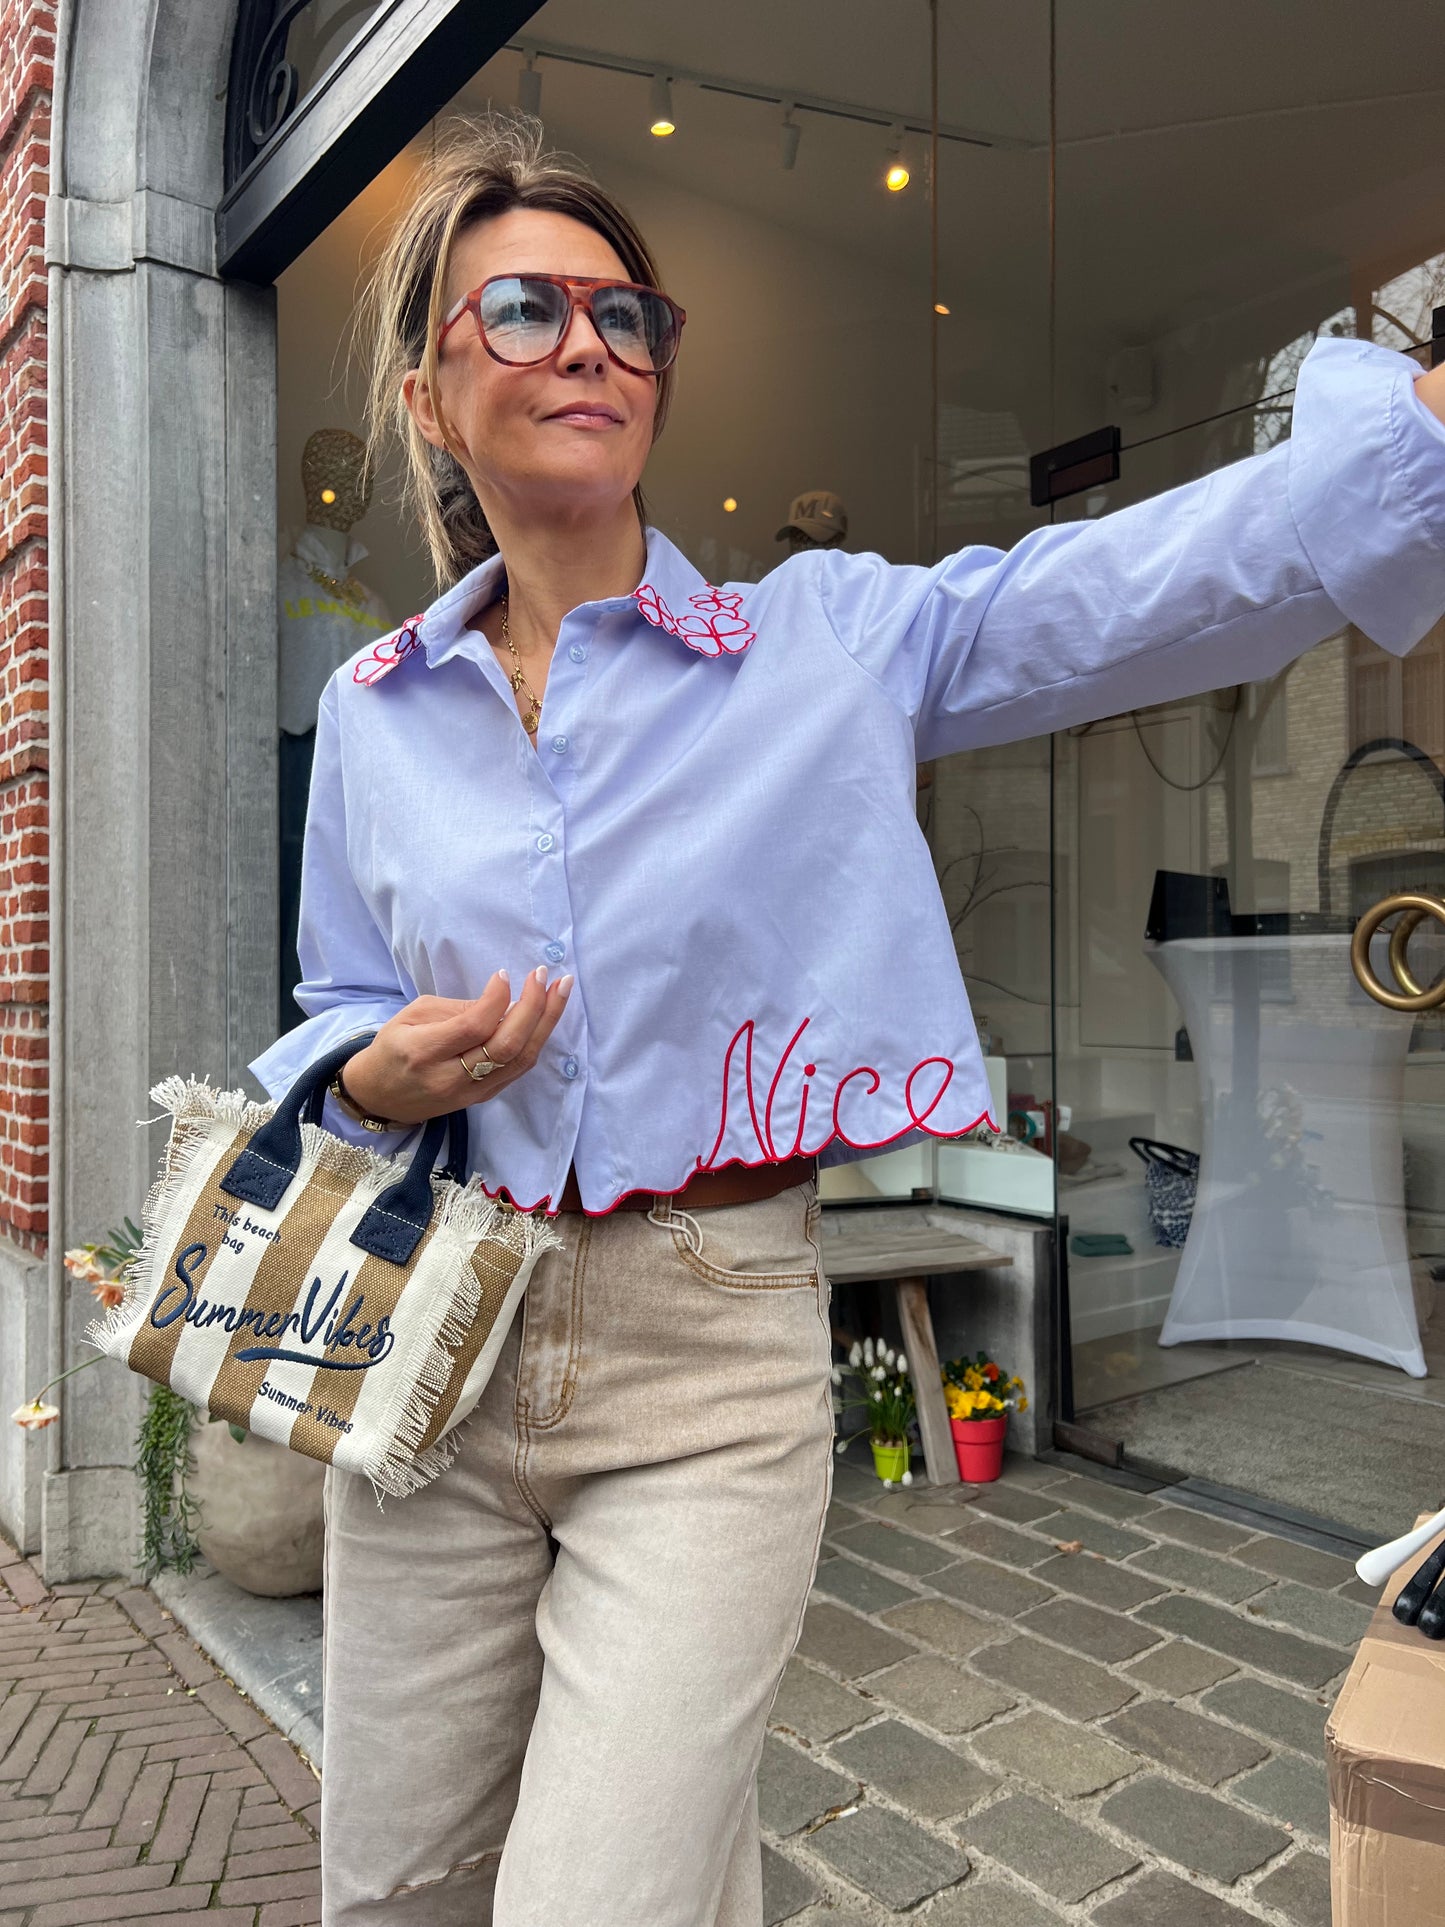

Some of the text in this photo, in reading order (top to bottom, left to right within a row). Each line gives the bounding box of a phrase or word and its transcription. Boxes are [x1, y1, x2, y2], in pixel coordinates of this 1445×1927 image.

[697, 1016, 988, 1171] Nice
[213, 1203, 281, 1243] This beach
[221, 1231, 245, 1255] bag
[257, 1381, 354, 1434] Summer Vibes
